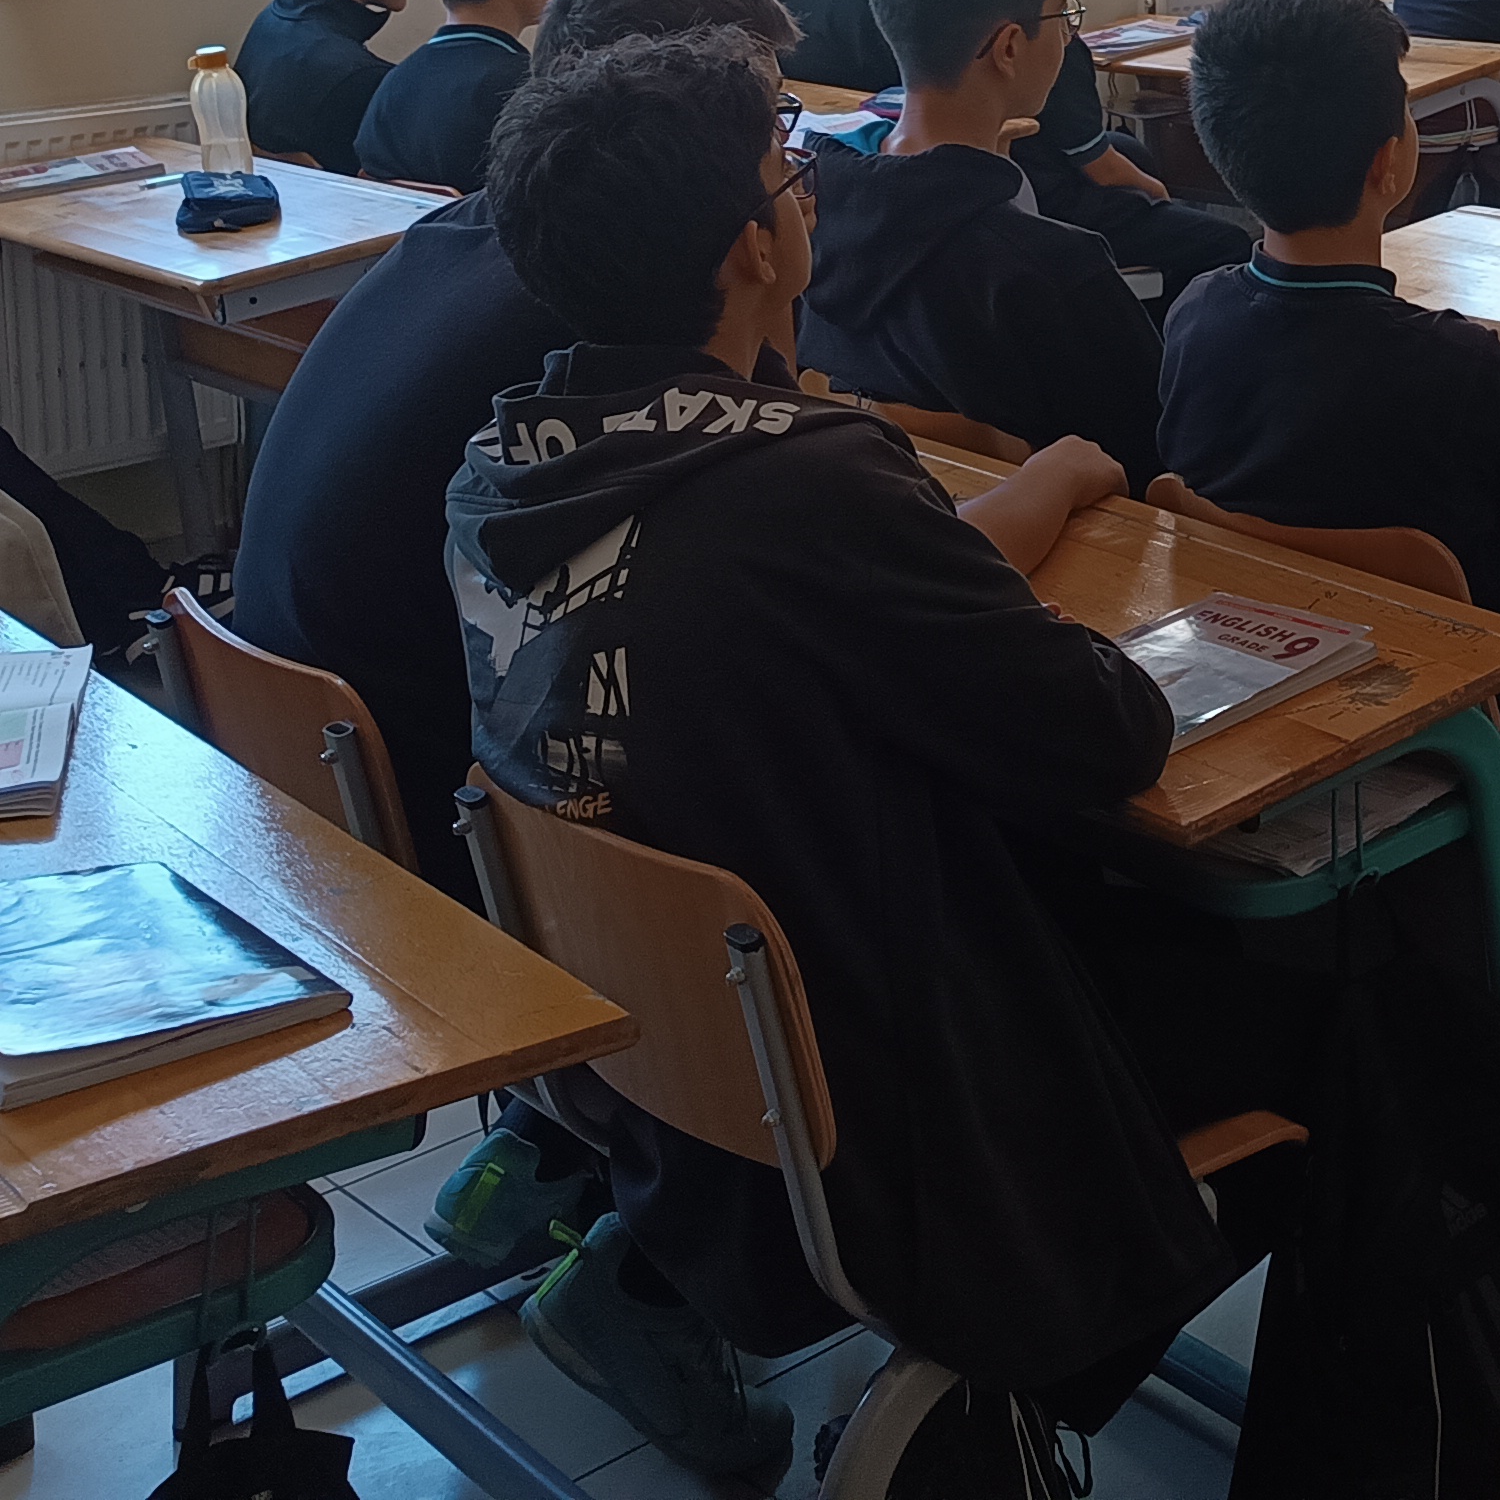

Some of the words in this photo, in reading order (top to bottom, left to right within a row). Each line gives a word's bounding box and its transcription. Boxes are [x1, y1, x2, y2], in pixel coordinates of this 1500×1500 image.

[1197, 609, 1295, 643] ENGLISH
[1272, 636, 1320, 660] 9
[1217, 632, 1270, 653] GRADE
[546, 792, 614, 820] ENGE
